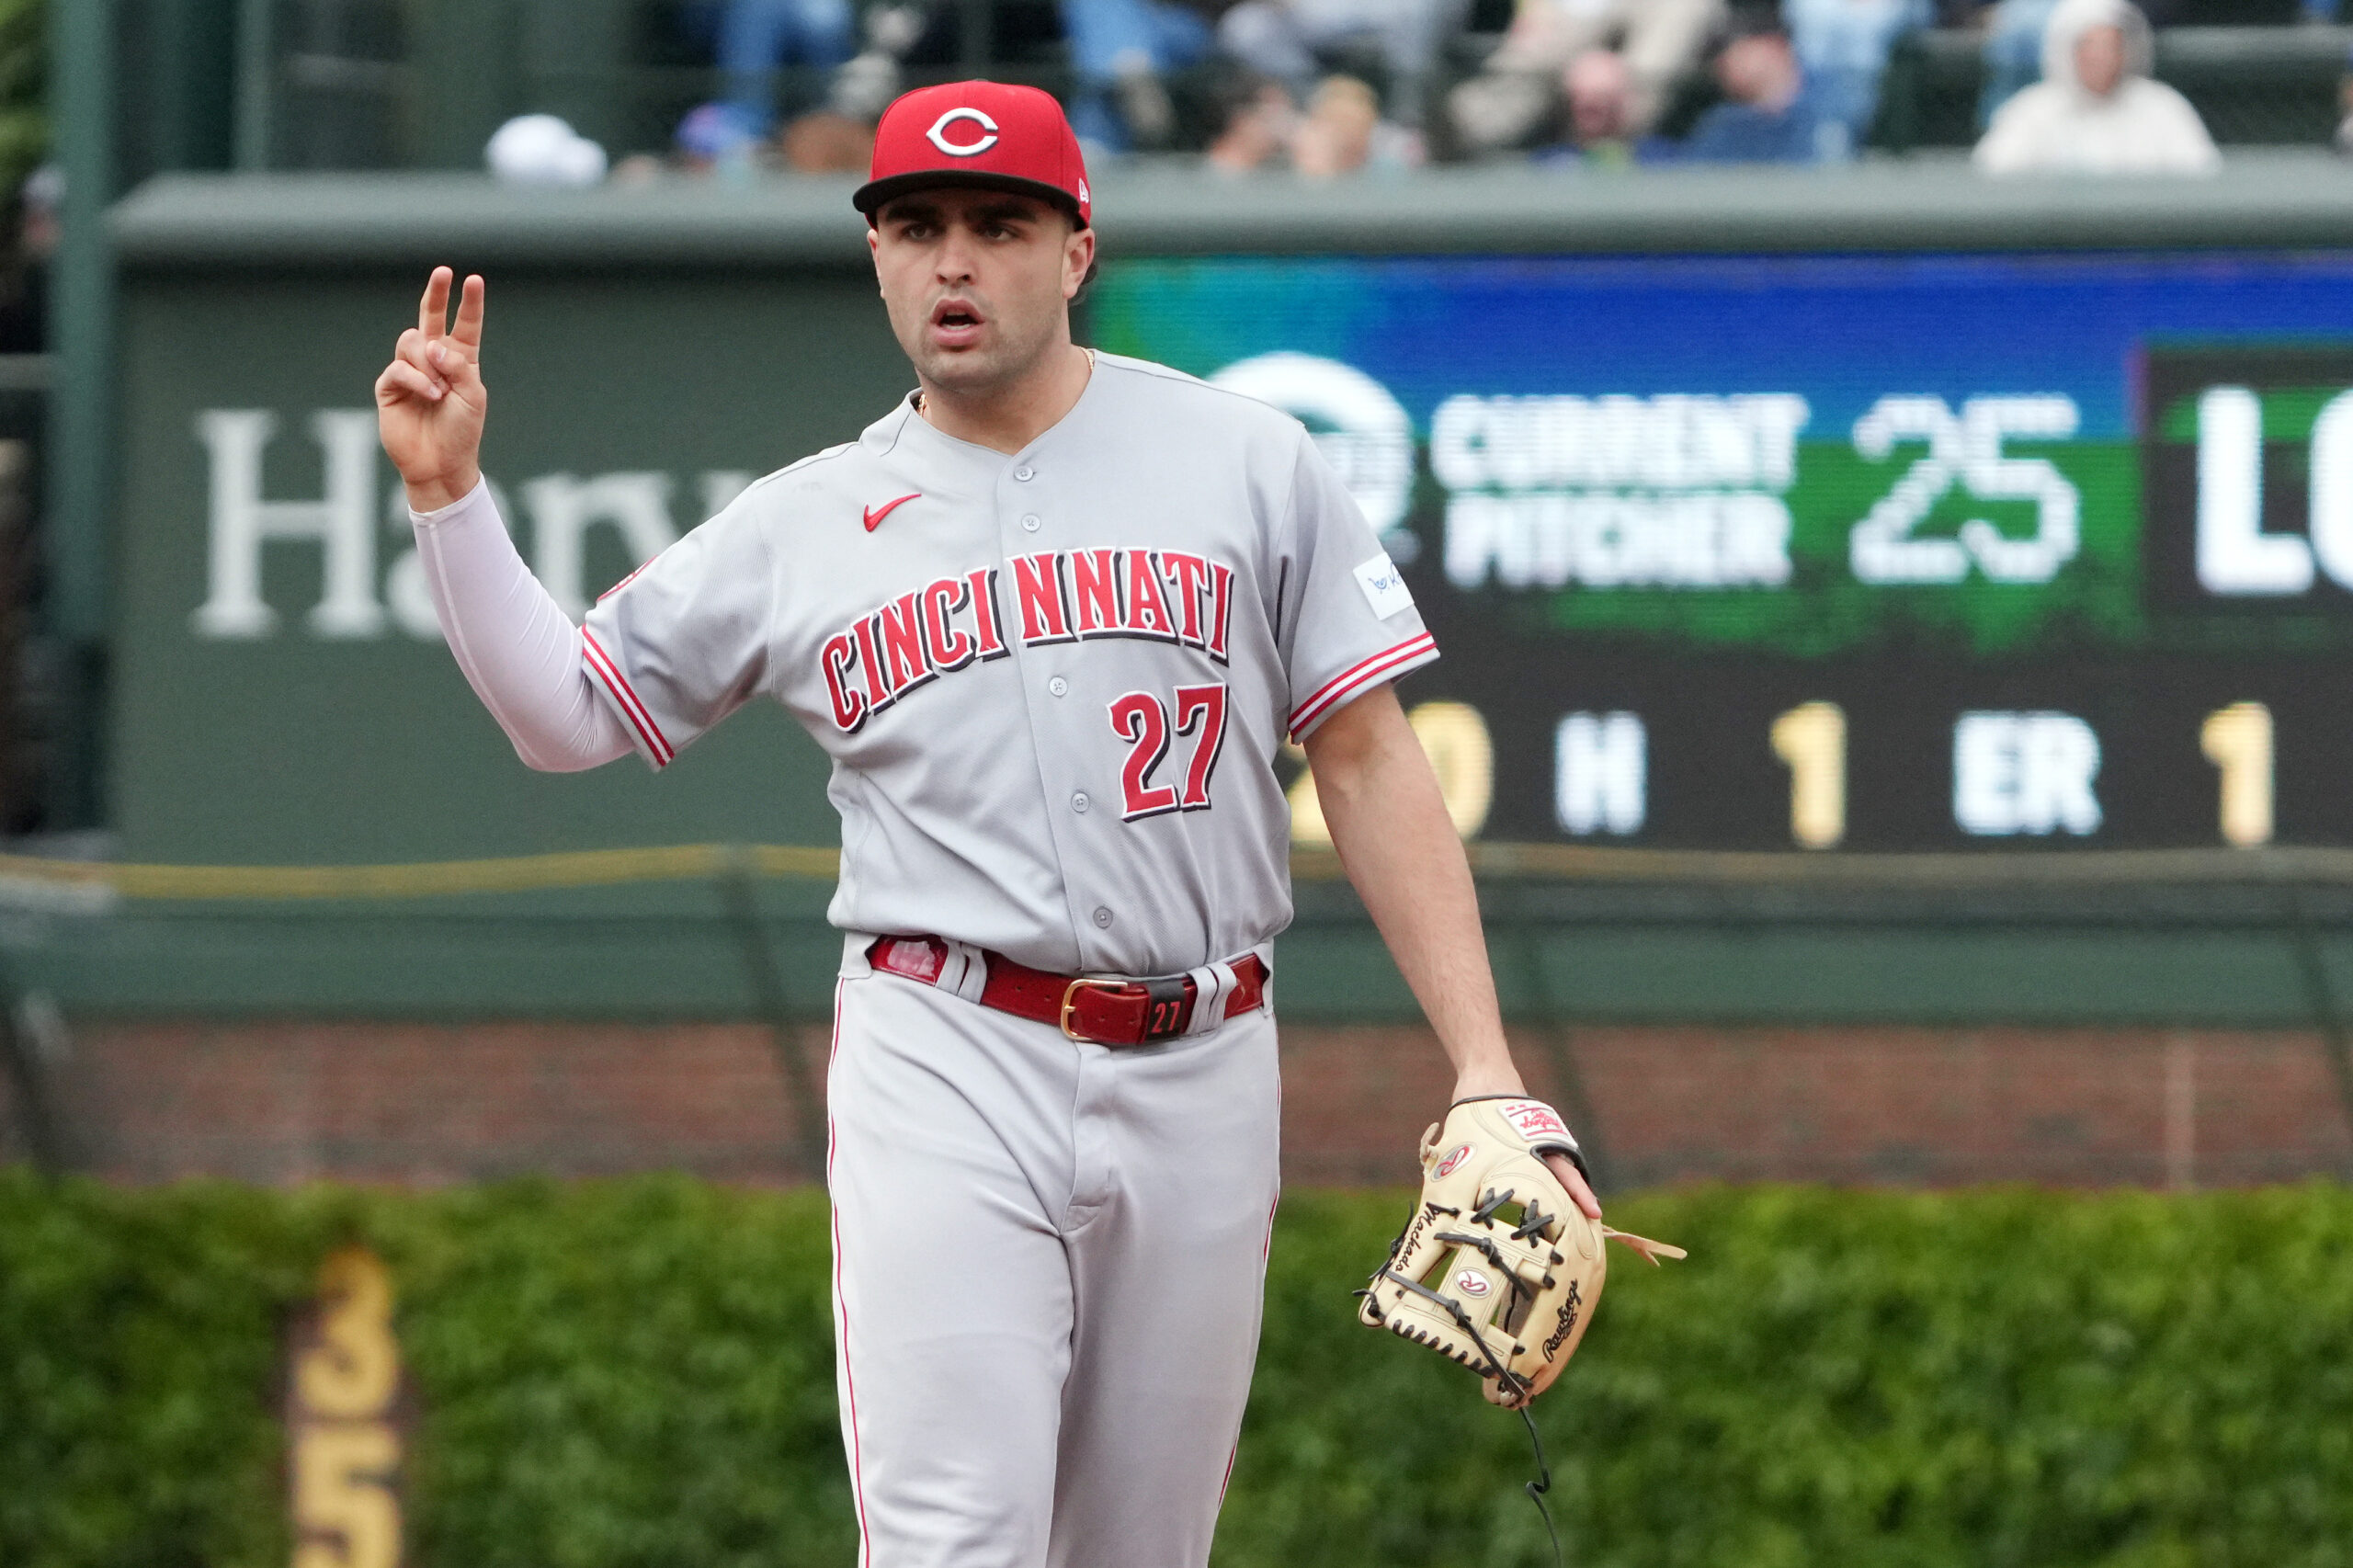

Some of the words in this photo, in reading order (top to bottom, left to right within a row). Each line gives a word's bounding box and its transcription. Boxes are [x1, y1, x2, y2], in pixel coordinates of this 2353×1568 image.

[926, 108, 999, 157] C
[1850, 392, 2081, 585] 25
[1108, 681, 1228, 823] 27
[1554, 709, 1647, 835] H
[1770, 700, 1847, 849] 1
[1953, 709, 2103, 836] ER
[2200, 700, 2276, 847] 1
[1151, 1001, 1181, 1033] 27
[1542, 1278, 1581, 1363] Rawlings
